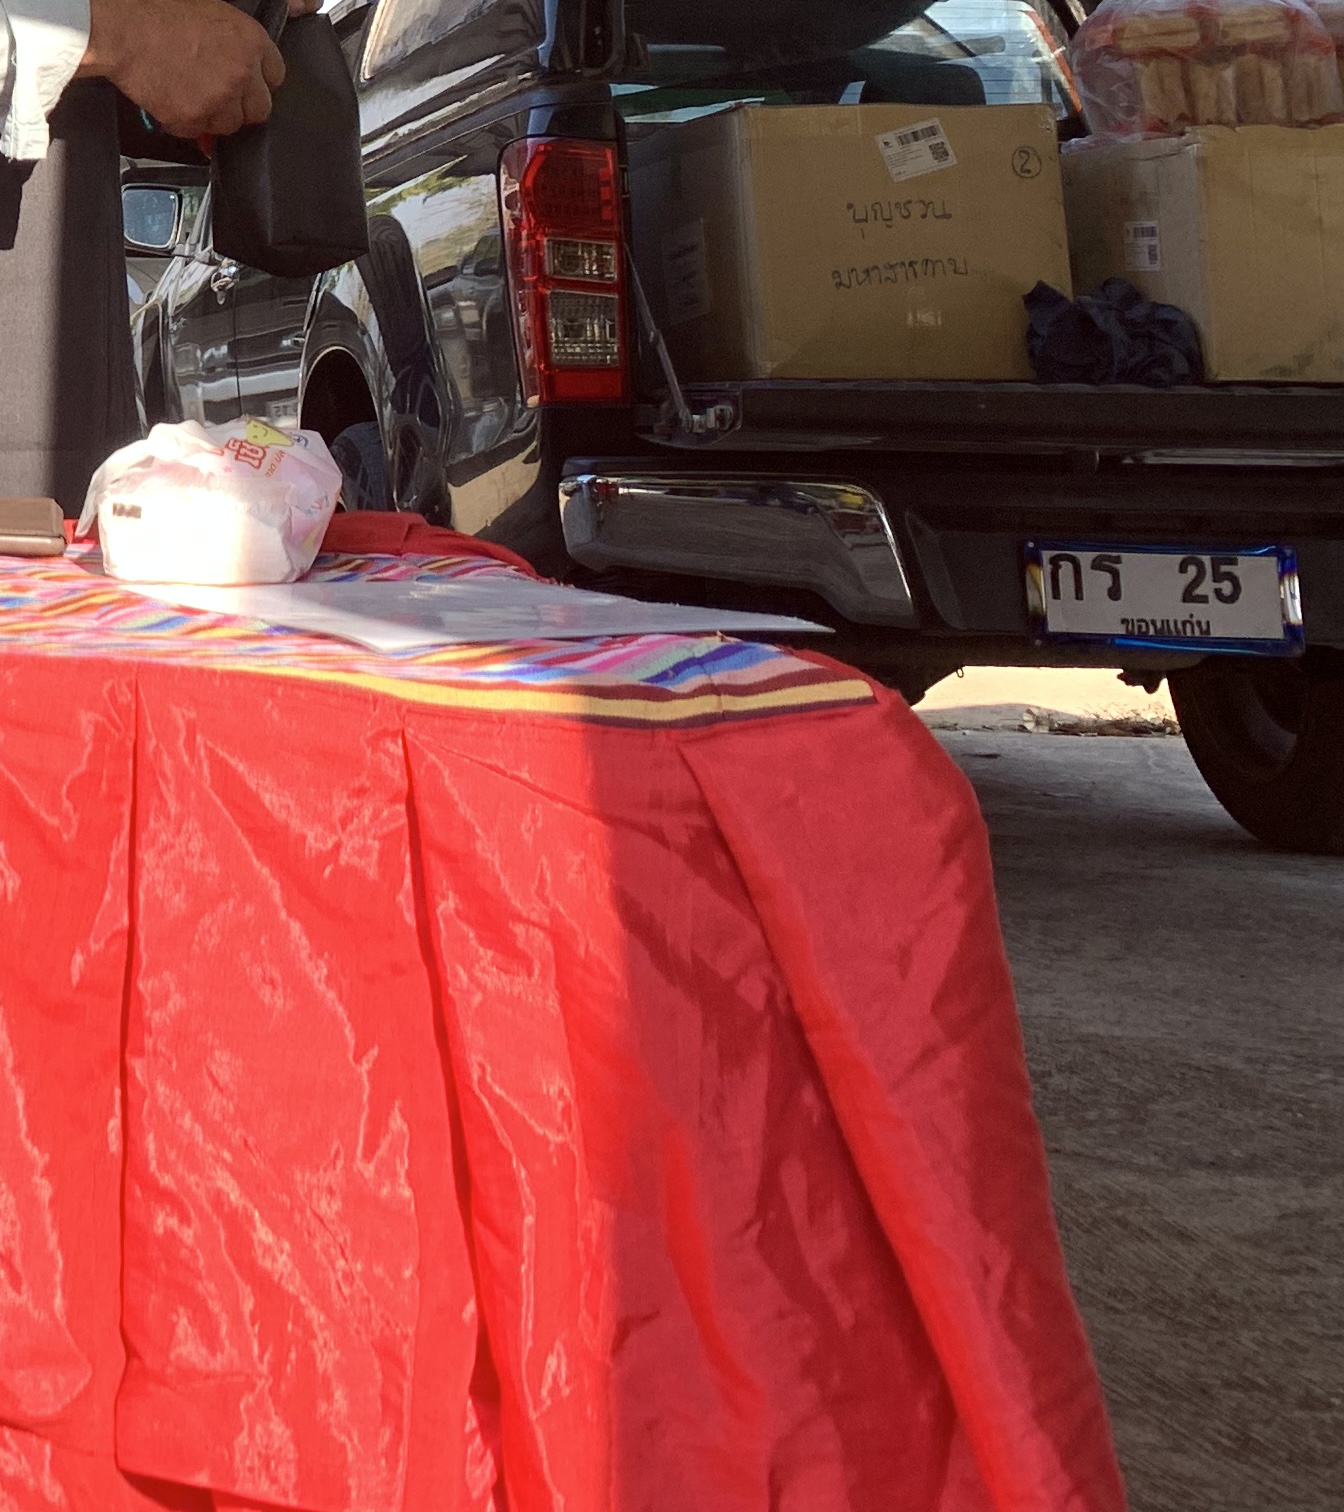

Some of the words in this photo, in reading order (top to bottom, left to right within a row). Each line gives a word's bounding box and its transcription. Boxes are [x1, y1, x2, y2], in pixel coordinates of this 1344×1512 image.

[846, 199, 953, 239] บุญชวน
[1049, 553, 1122, 601] กร
[1178, 556, 1242, 604] 25
[1120, 613, 1212, 636] ขอนแก่น
